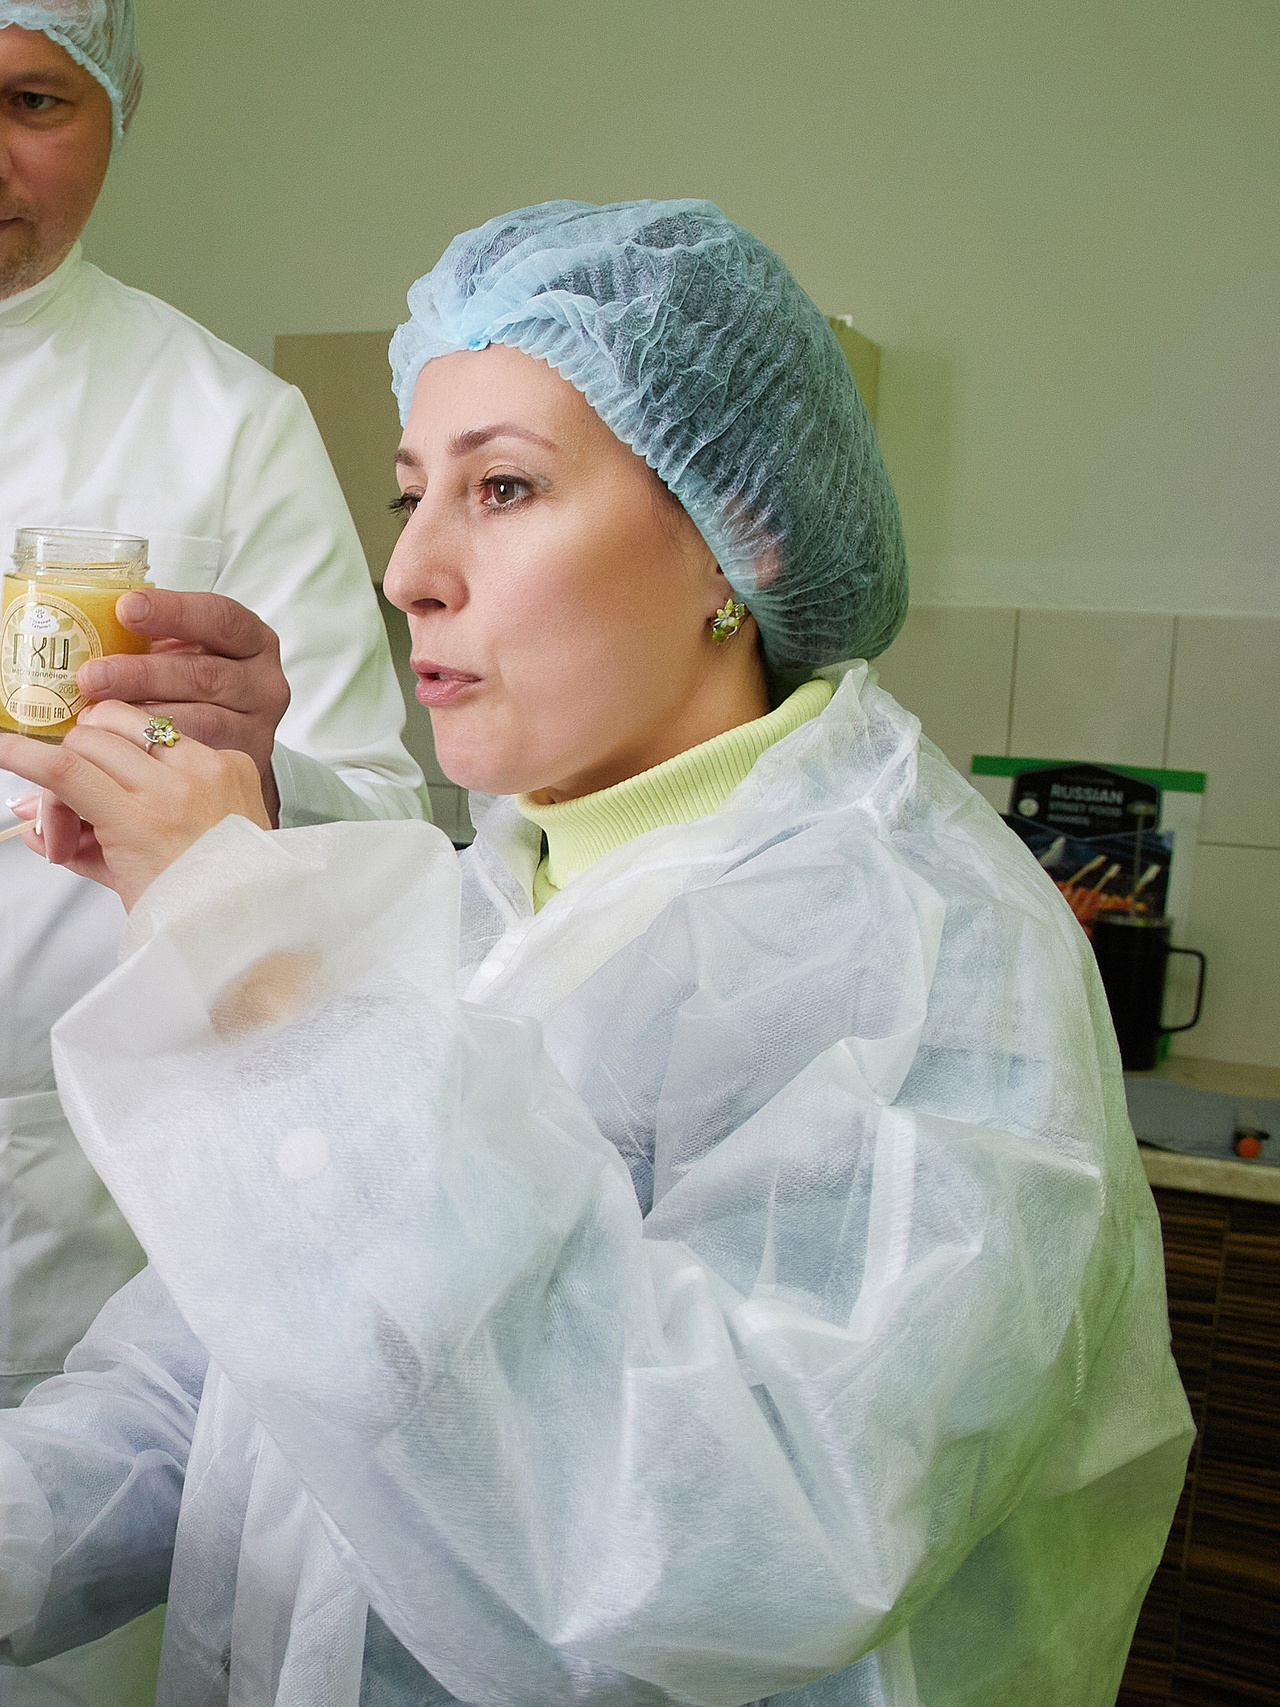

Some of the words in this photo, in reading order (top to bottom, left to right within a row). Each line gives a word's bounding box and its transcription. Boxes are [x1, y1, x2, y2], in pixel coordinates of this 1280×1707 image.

[13, 633, 69, 670] ГХИ
[58, 686, 73, 694] 200
[53, 707, 65, 719] EAC
[1050, 783, 1124, 805] RUSSIAN
